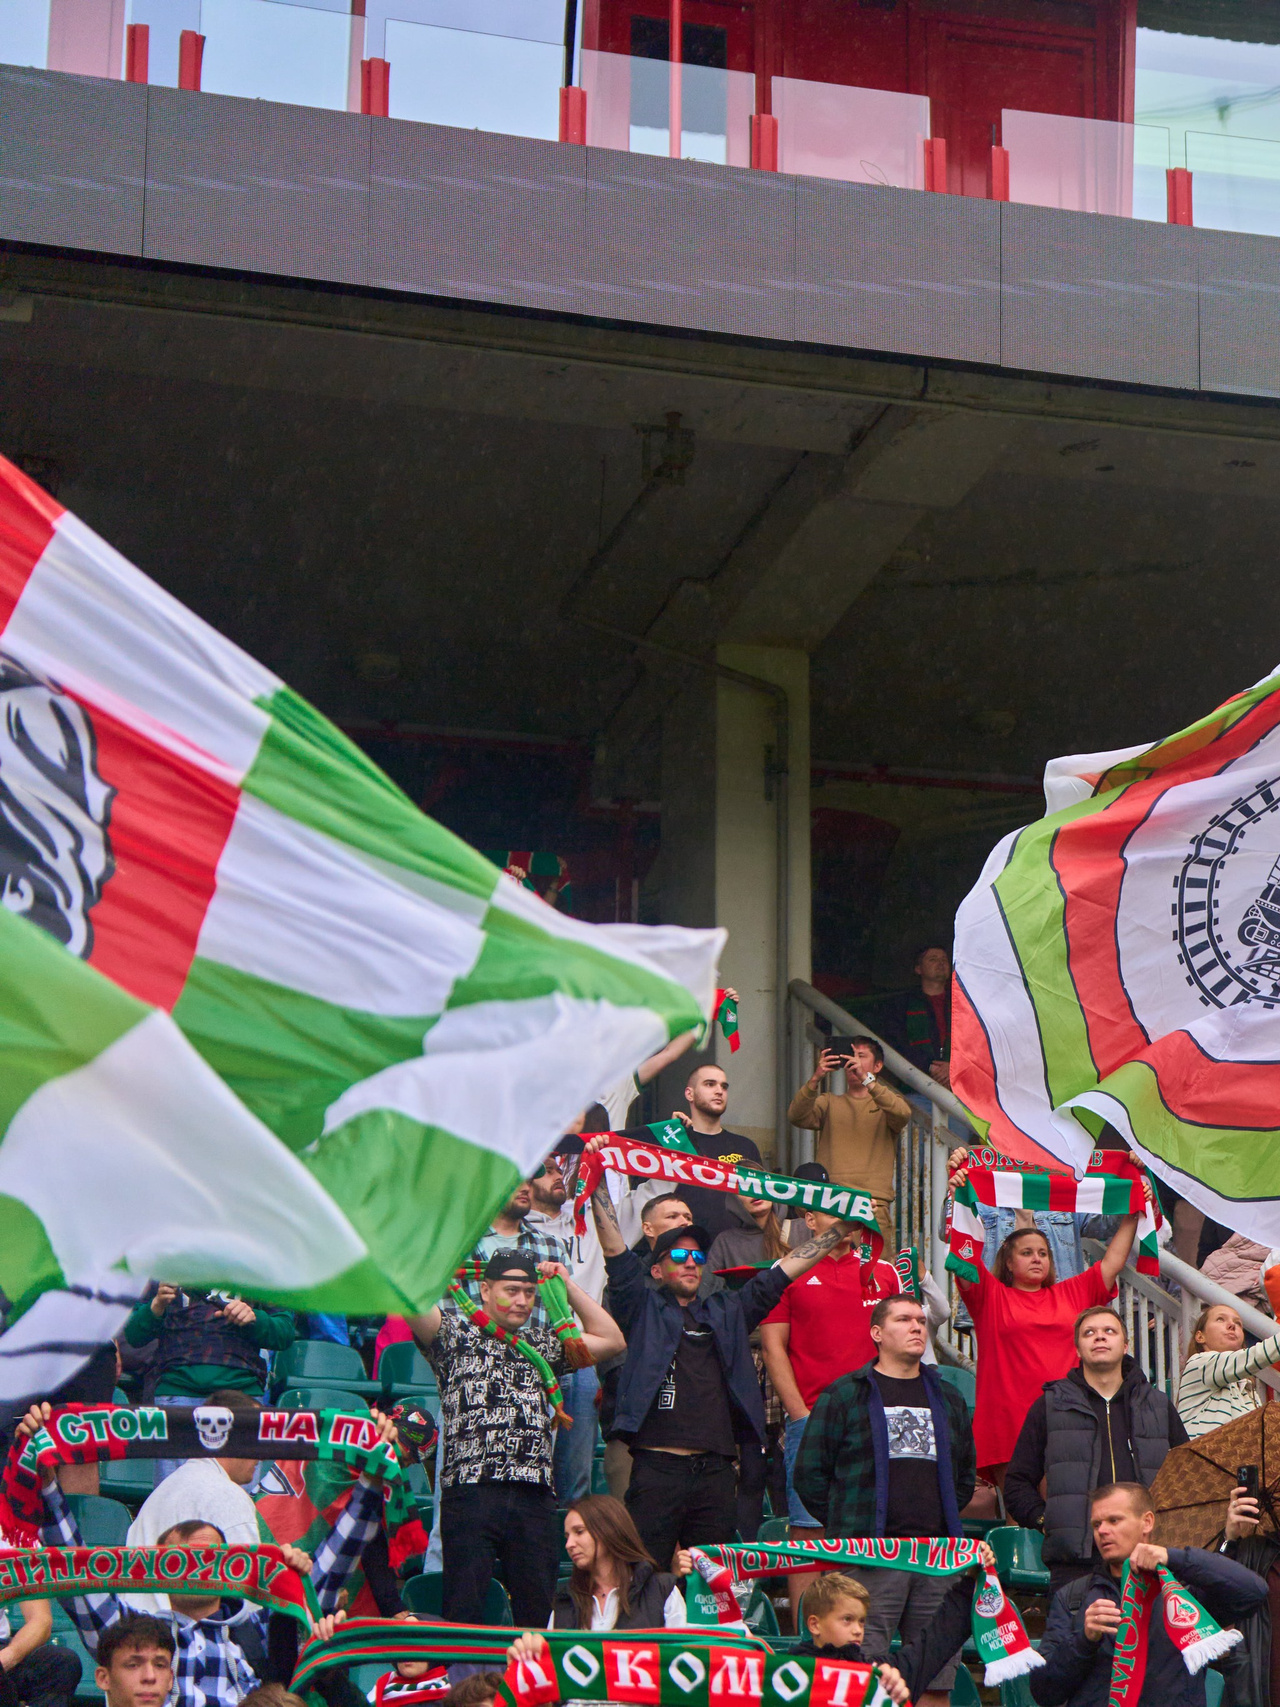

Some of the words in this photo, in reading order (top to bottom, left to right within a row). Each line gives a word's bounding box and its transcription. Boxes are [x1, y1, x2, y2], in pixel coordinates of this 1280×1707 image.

[599, 1146, 875, 1221] ЛОКОМОТИВ
[57, 1406, 169, 1446] СТОЙ
[258, 1411, 320, 1443] НА
[328, 1414, 392, 1457] ПУ
[0, 1549, 288, 1593] ЛОКОМОТИВ
[980, 1620, 1019, 1645] ЛОКОМОТИВ
[988, 1632, 1016, 1651] МОСКВА
